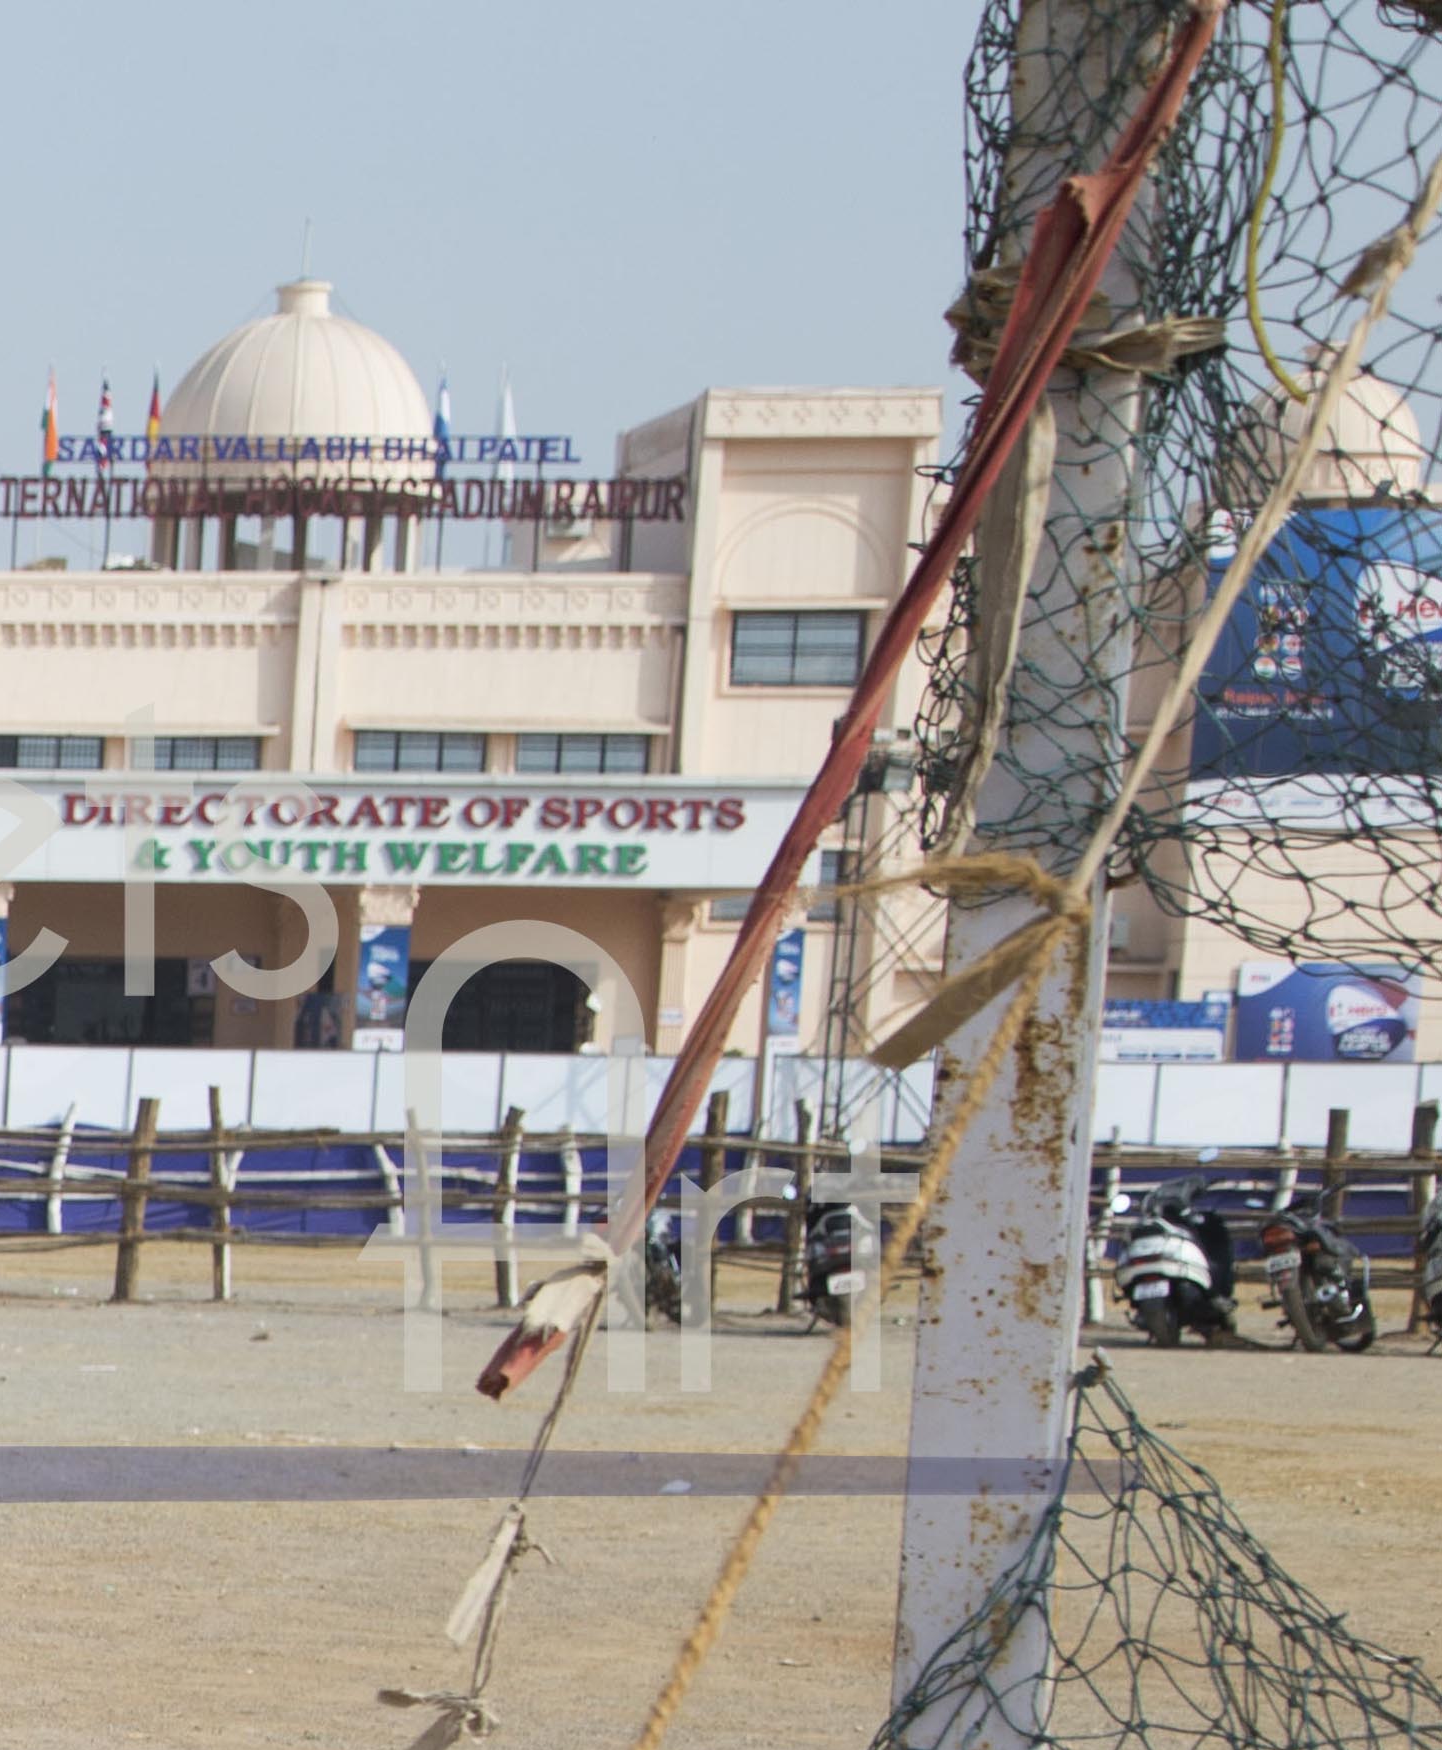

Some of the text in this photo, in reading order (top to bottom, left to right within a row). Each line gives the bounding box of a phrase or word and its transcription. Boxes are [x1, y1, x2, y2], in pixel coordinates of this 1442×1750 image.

[57, 436, 581, 463] SARDAR VALLABH BHAI PATEL
[246, 478, 390, 517] HOCKEY
[399, 479, 545, 520] STADIUM
[553, 479, 686, 521] RAIPUR
[1396, 594, 1442, 618] He
[63, 794, 747, 831] DIRECTORATE OF SPORTS
[134, 839, 648, 876] & YOUTH WELFARE
